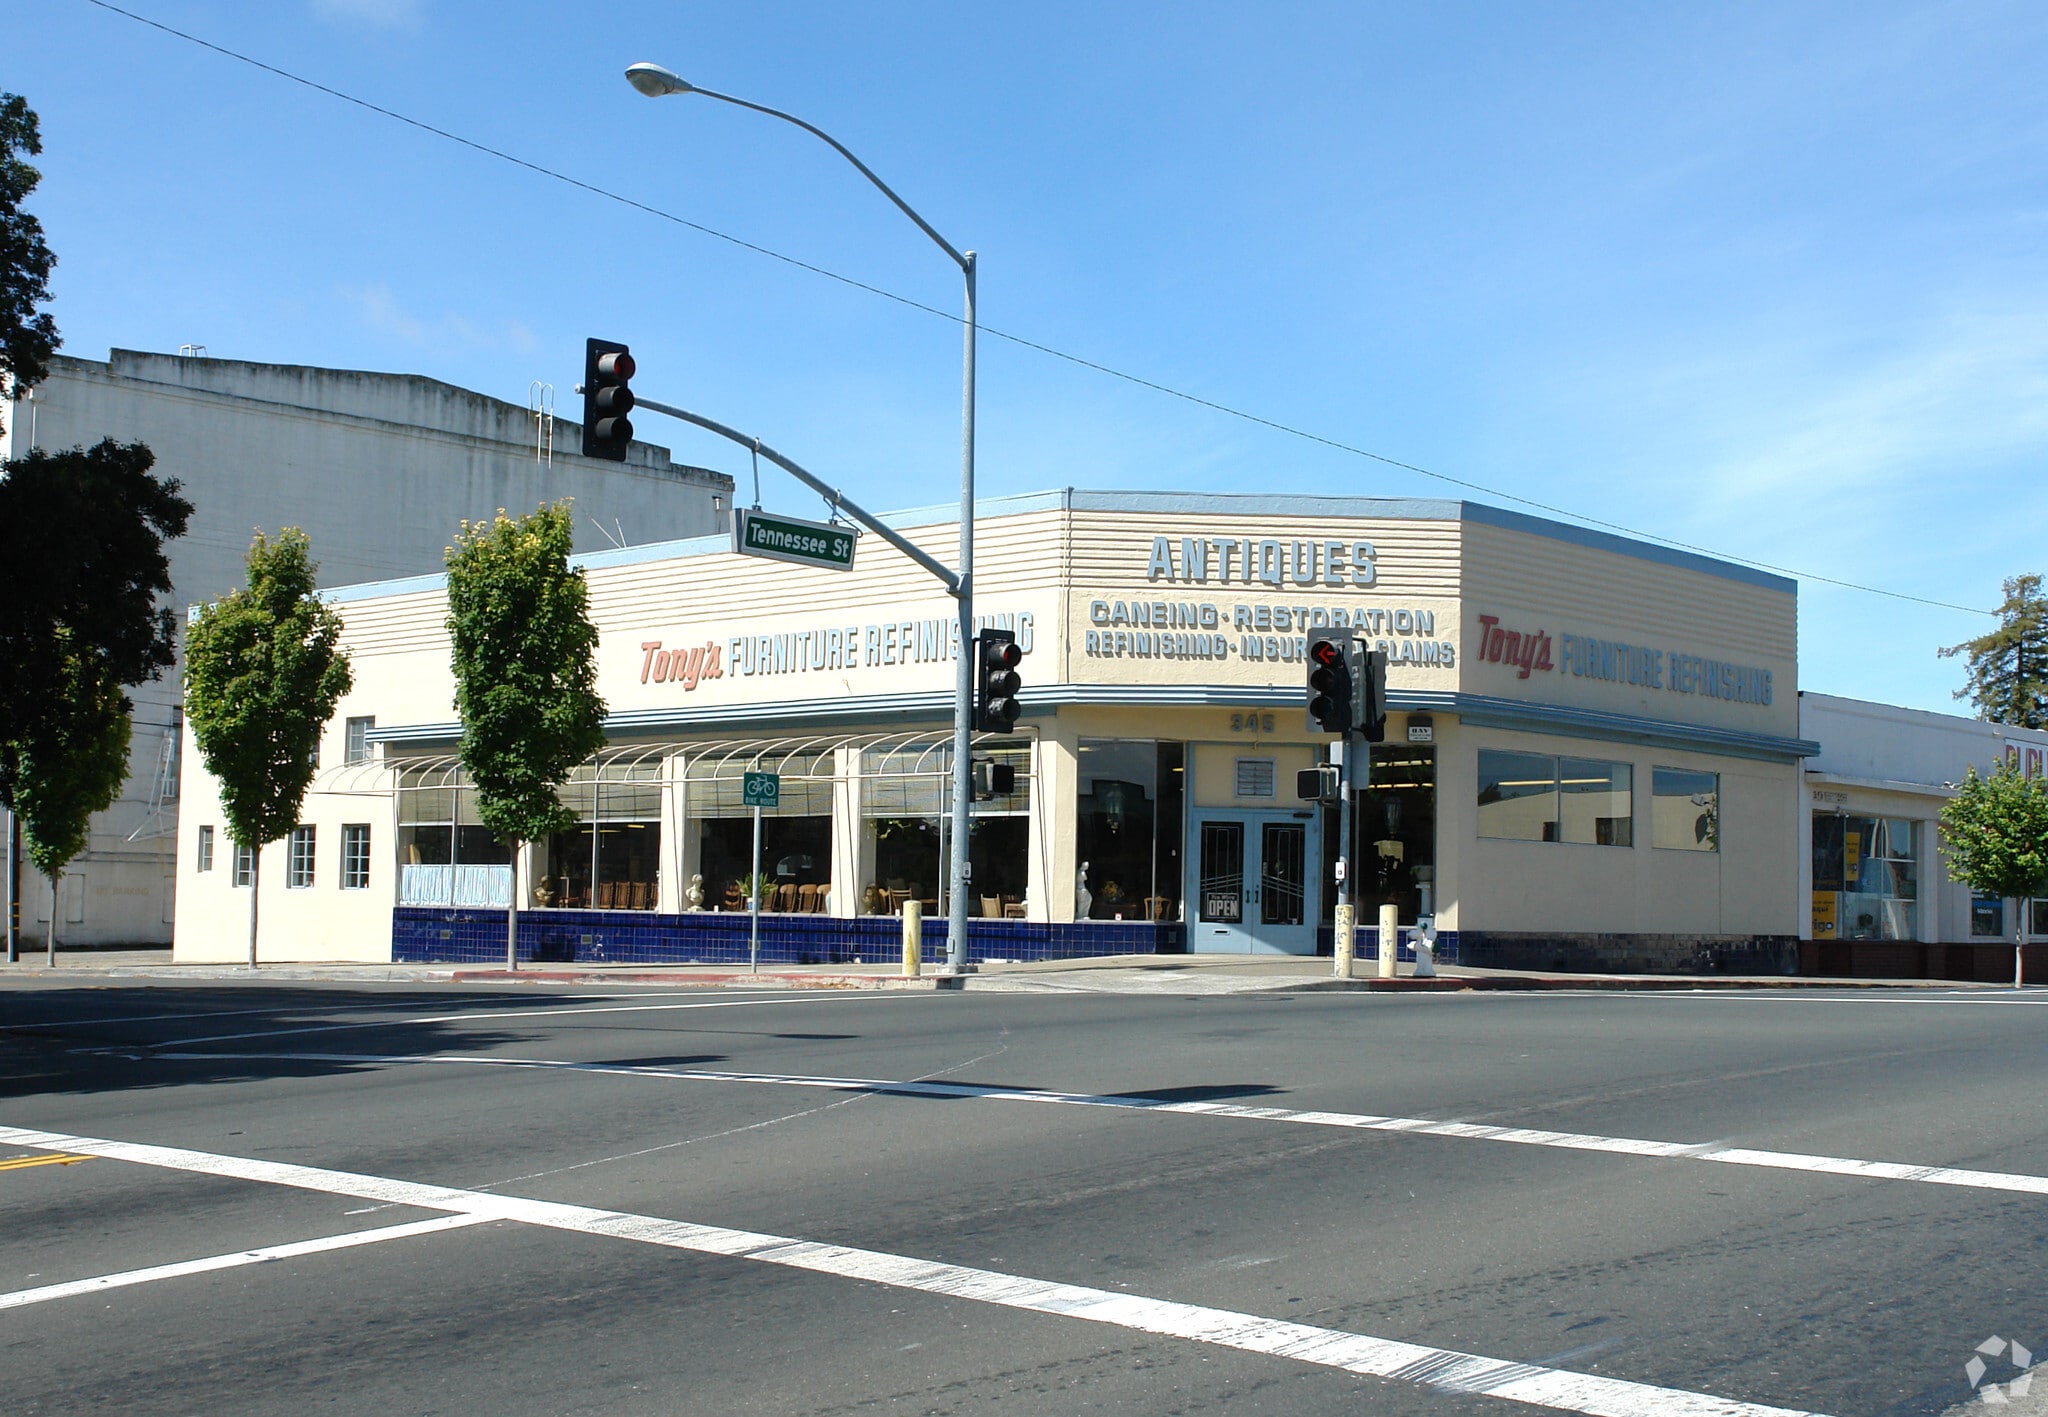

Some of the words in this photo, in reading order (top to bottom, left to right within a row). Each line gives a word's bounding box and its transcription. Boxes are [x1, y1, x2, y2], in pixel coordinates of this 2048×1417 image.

[751, 523, 827, 554] Tennessee
[832, 538, 849, 558] St
[1147, 536, 1377, 587] ANTIQUES
[1090, 600, 1217, 629] CANEING
[1233, 604, 1435, 635] RESTORATION
[640, 641, 723, 691] Tony's
[728, 626, 857, 677] FURNITURE
[1085, 630, 1226, 658] REFINISHING
[1478, 614, 1554, 679] Tony's
[1560, 633, 1663, 690] FURNITURE
[1666, 652, 1773, 706] REFINISHING
[1231, 714, 1274, 733] 345
[1209, 900, 1238, 917] OPEN
